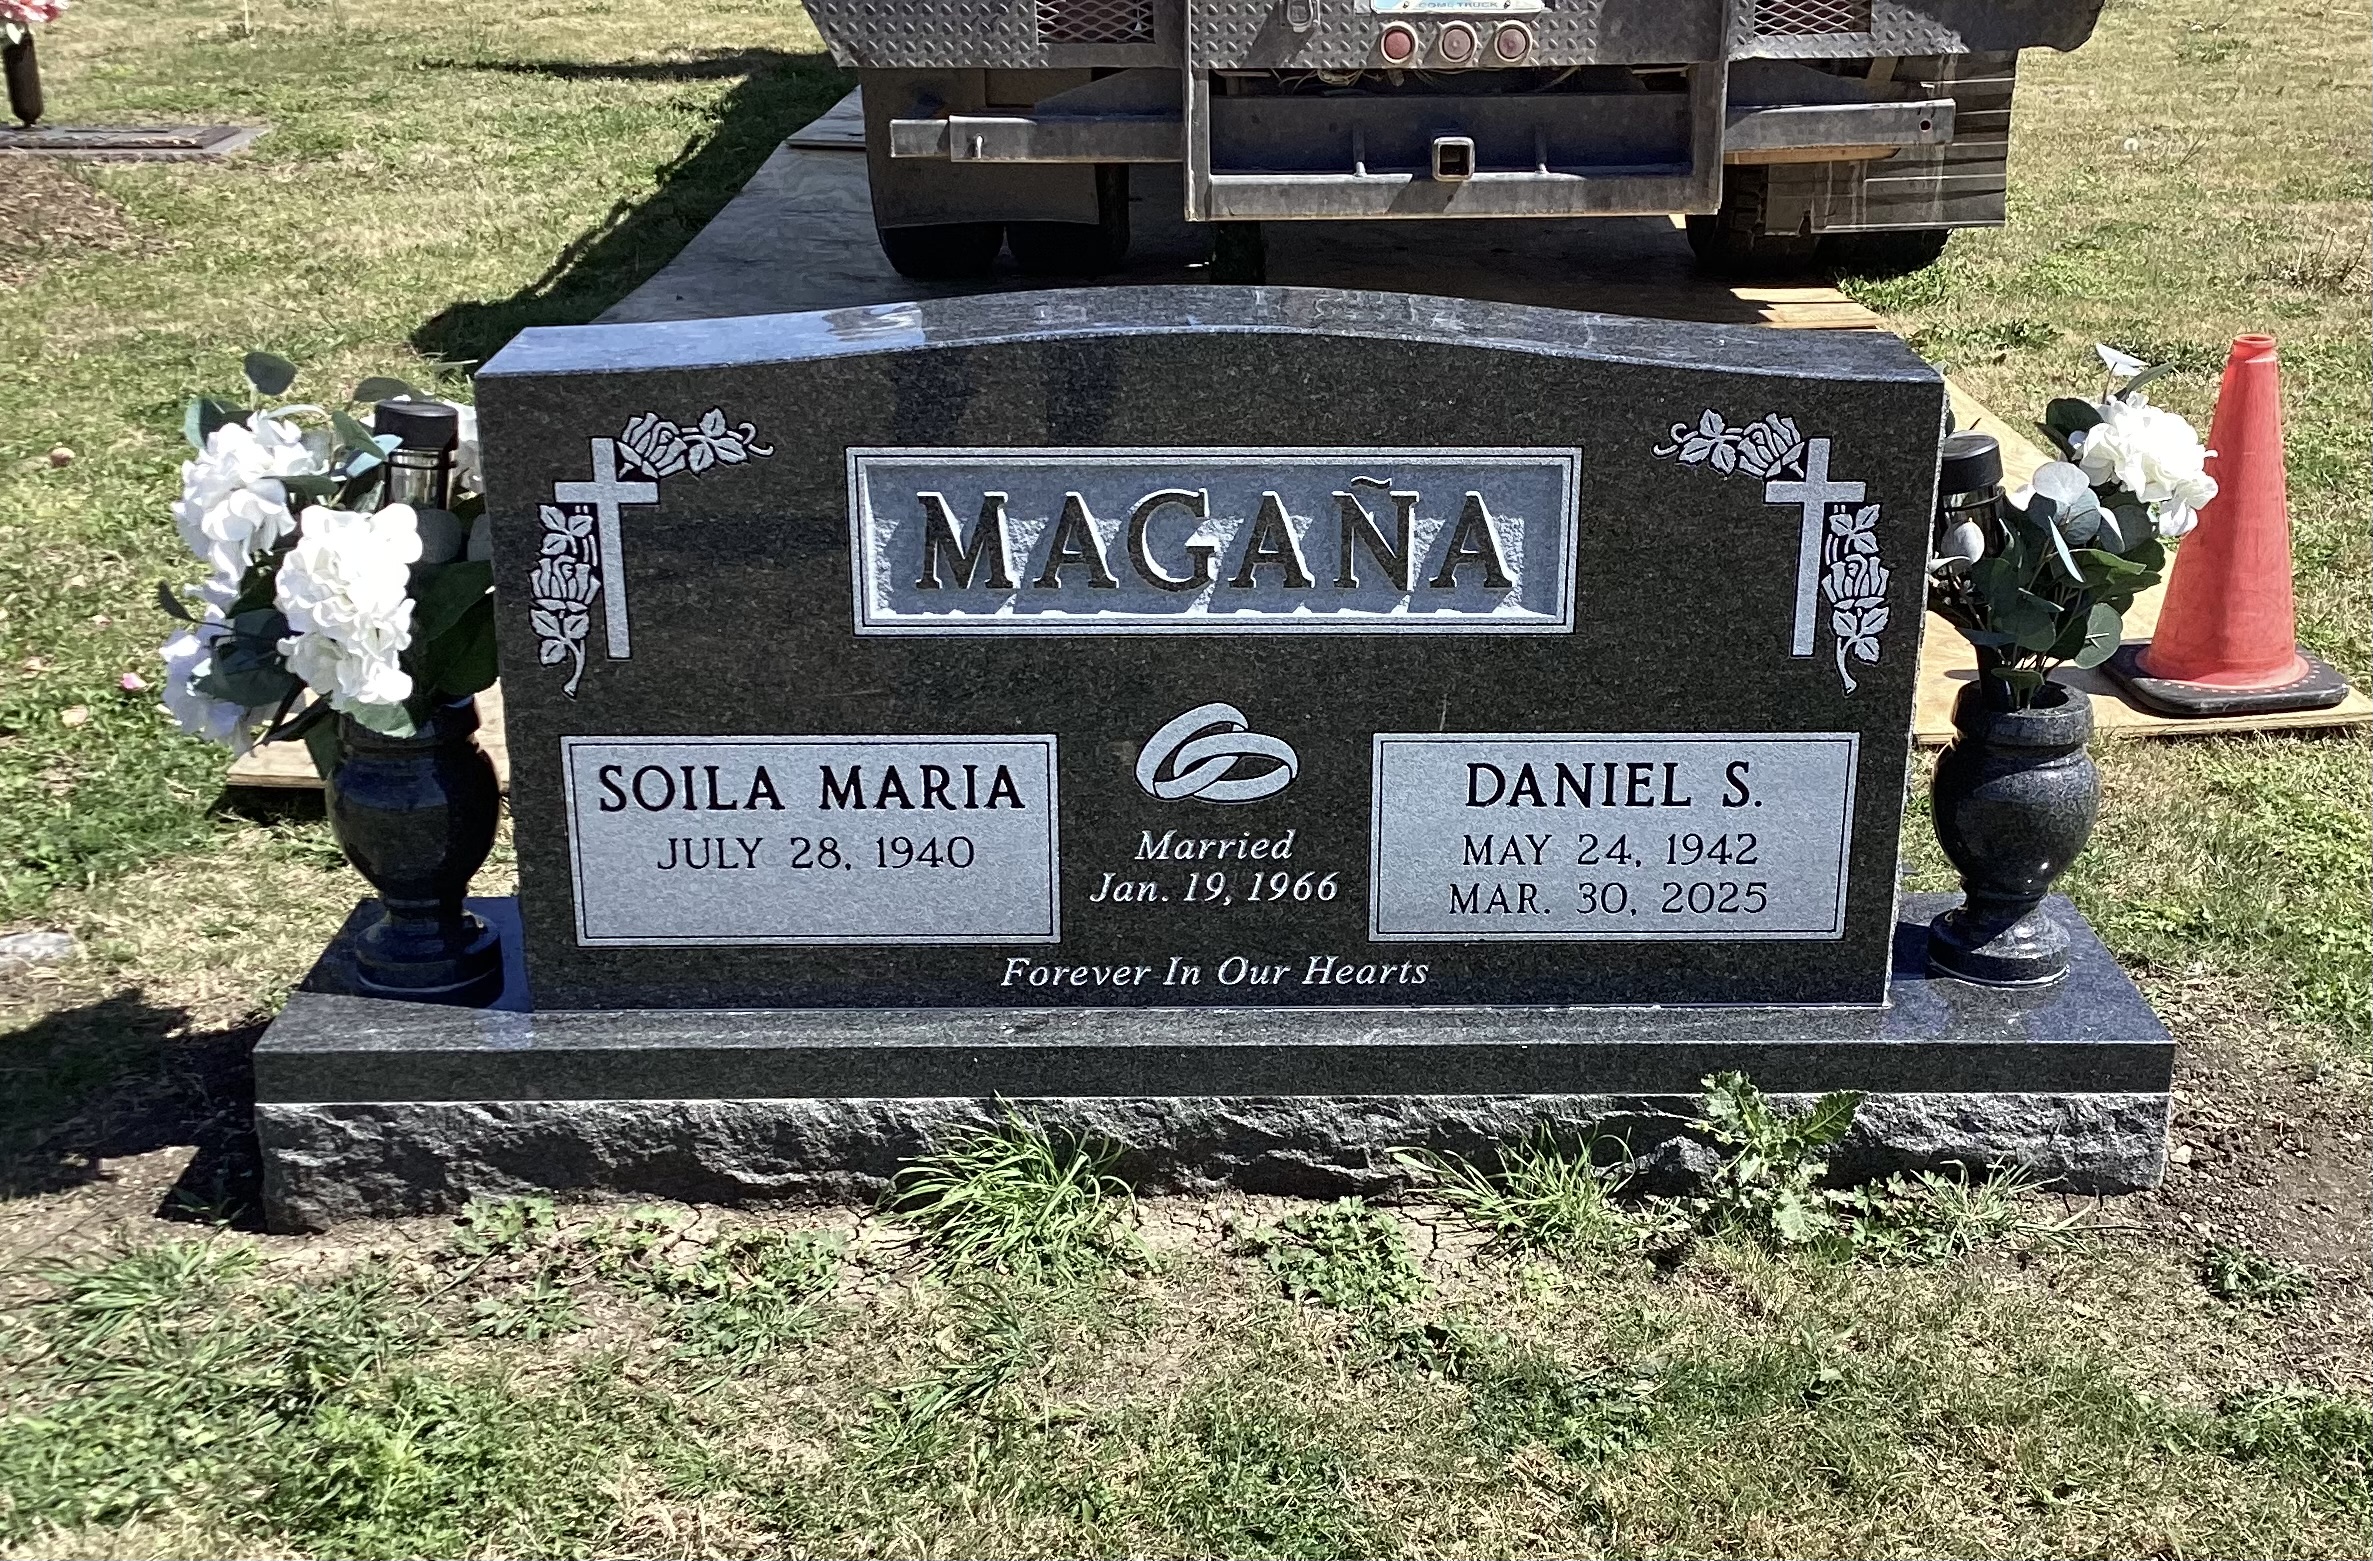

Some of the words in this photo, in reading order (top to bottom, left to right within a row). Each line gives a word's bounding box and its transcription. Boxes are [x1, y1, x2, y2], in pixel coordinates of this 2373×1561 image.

[916, 476, 1515, 592] MAGAÑA
[599, 764, 785, 812] SOILA
[818, 764, 1025, 811] MARIA
[1465, 762, 1691, 808] DANIEL
[1722, 761, 1762, 808] S.
[657, 837, 763, 870] JULY
[790, 837, 852, 871] 28,
[876, 836, 975, 868] 1940
[1135, 829, 1296, 860] Married
[1462, 834, 1552, 866] MAY
[1577, 833, 1642, 867] 24,
[1666, 833, 1758, 865] 1942
[1089, 872, 1168, 902] Jan.
[1184, 872, 1231, 906] 19,
[1248, 871, 1340, 901] 1966
[1449, 883, 1550, 914] MAR.
[1576, 883, 1637, 917] 30,
[1661, 882, 1767, 914] 2025
[1000, 957, 1151, 987] Forever
[1163, 957, 1200, 985] In
[1217, 956, 1291, 985] Our
[1301, 955, 1430, 985] Hearts
